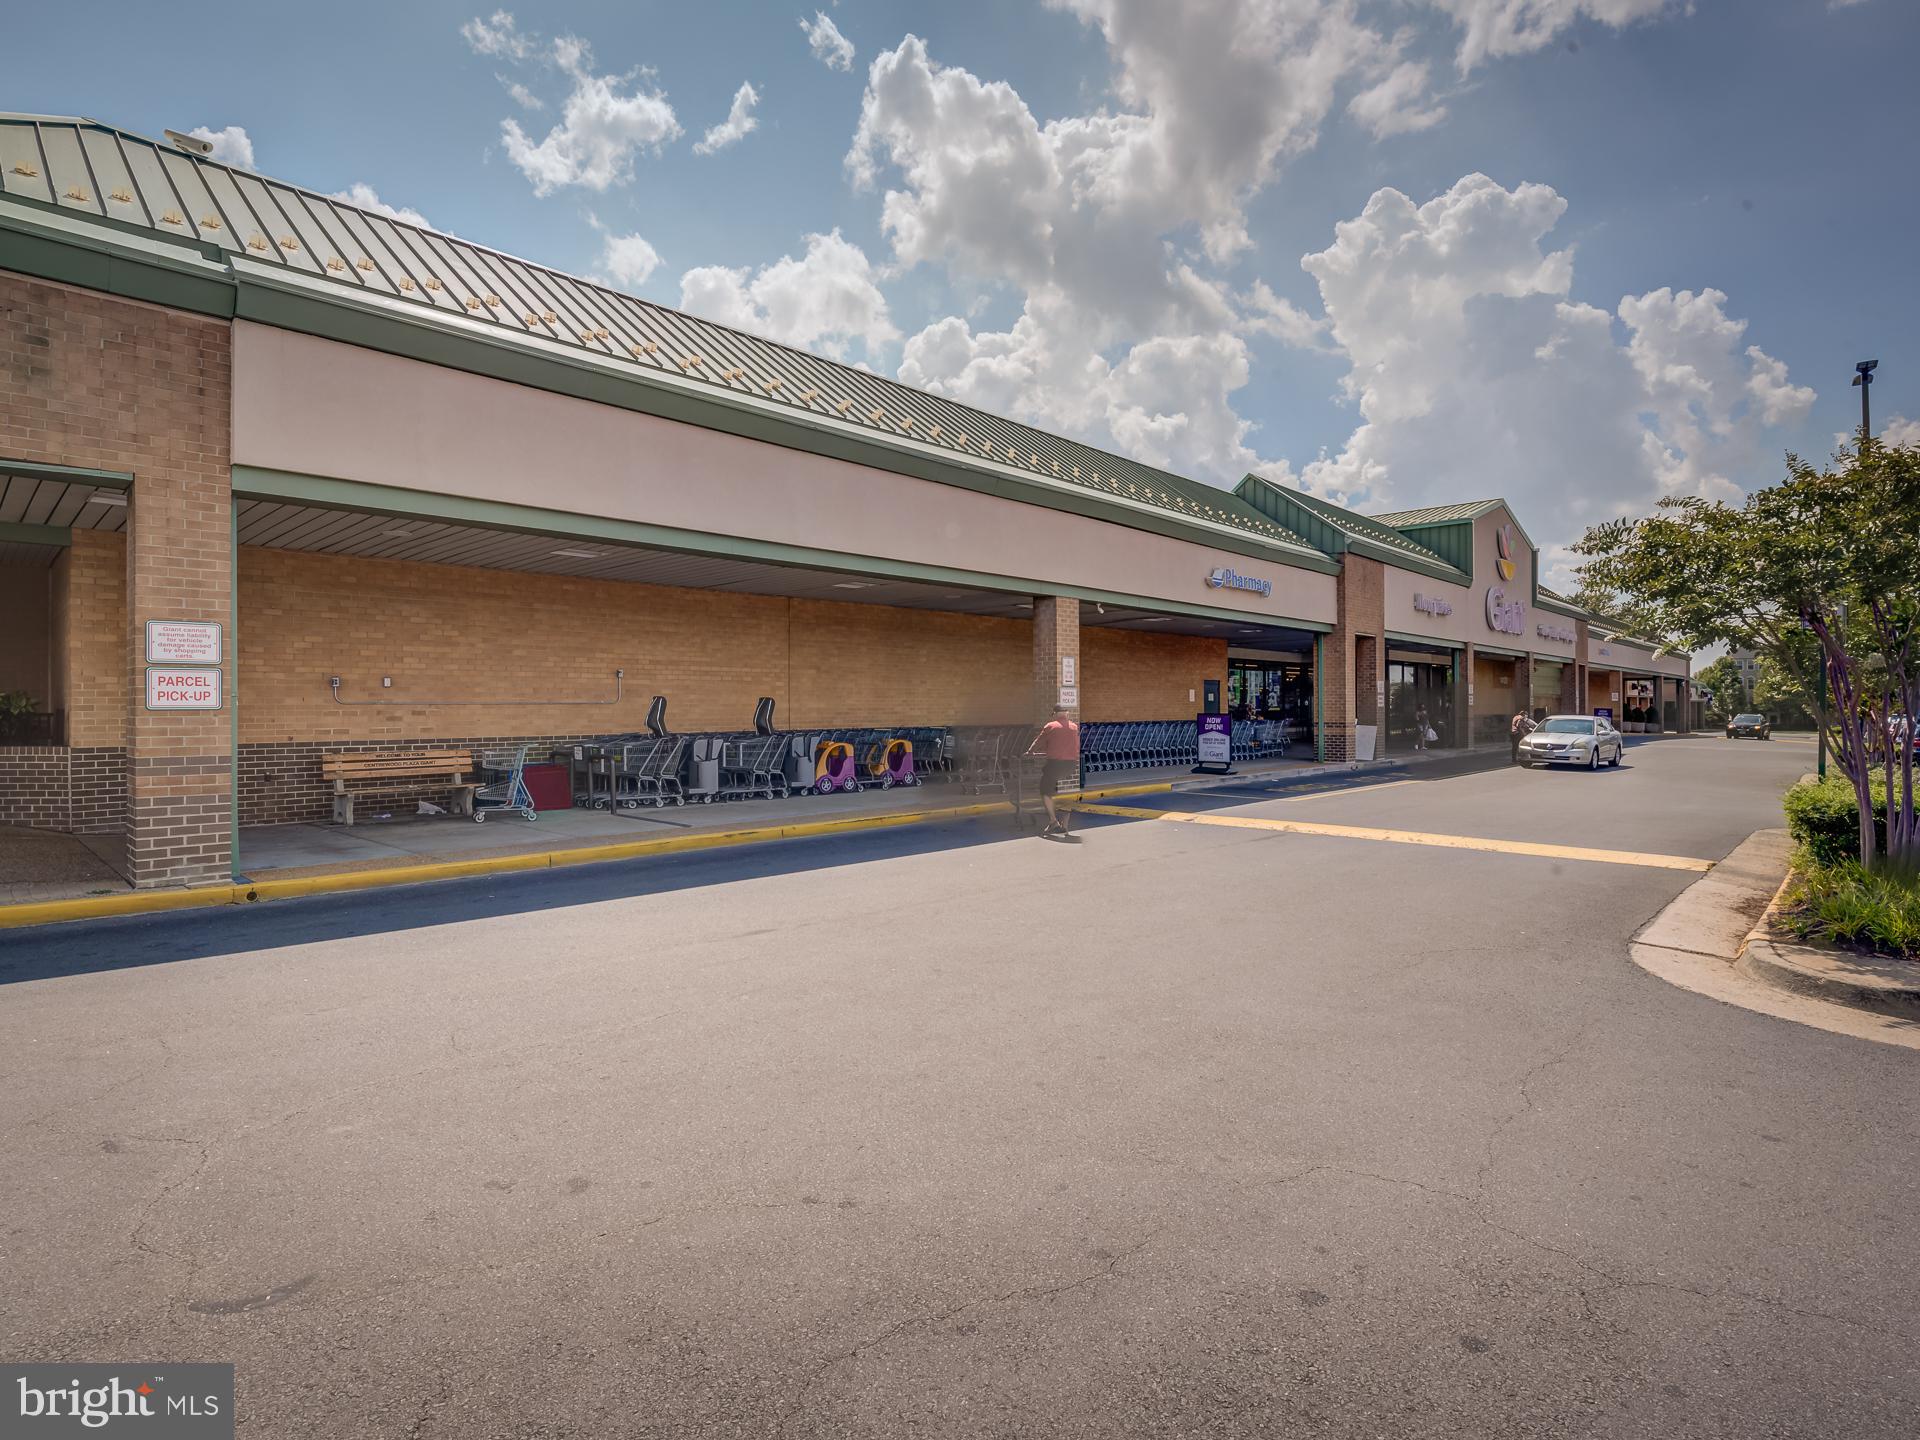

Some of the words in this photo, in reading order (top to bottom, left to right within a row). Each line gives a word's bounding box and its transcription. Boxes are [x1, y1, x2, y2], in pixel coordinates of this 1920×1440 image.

[1225, 568, 1272, 597] Pharmacy
[158, 676, 211, 686] PARCEL
[158, 691, 211, 701] PICK-UP
